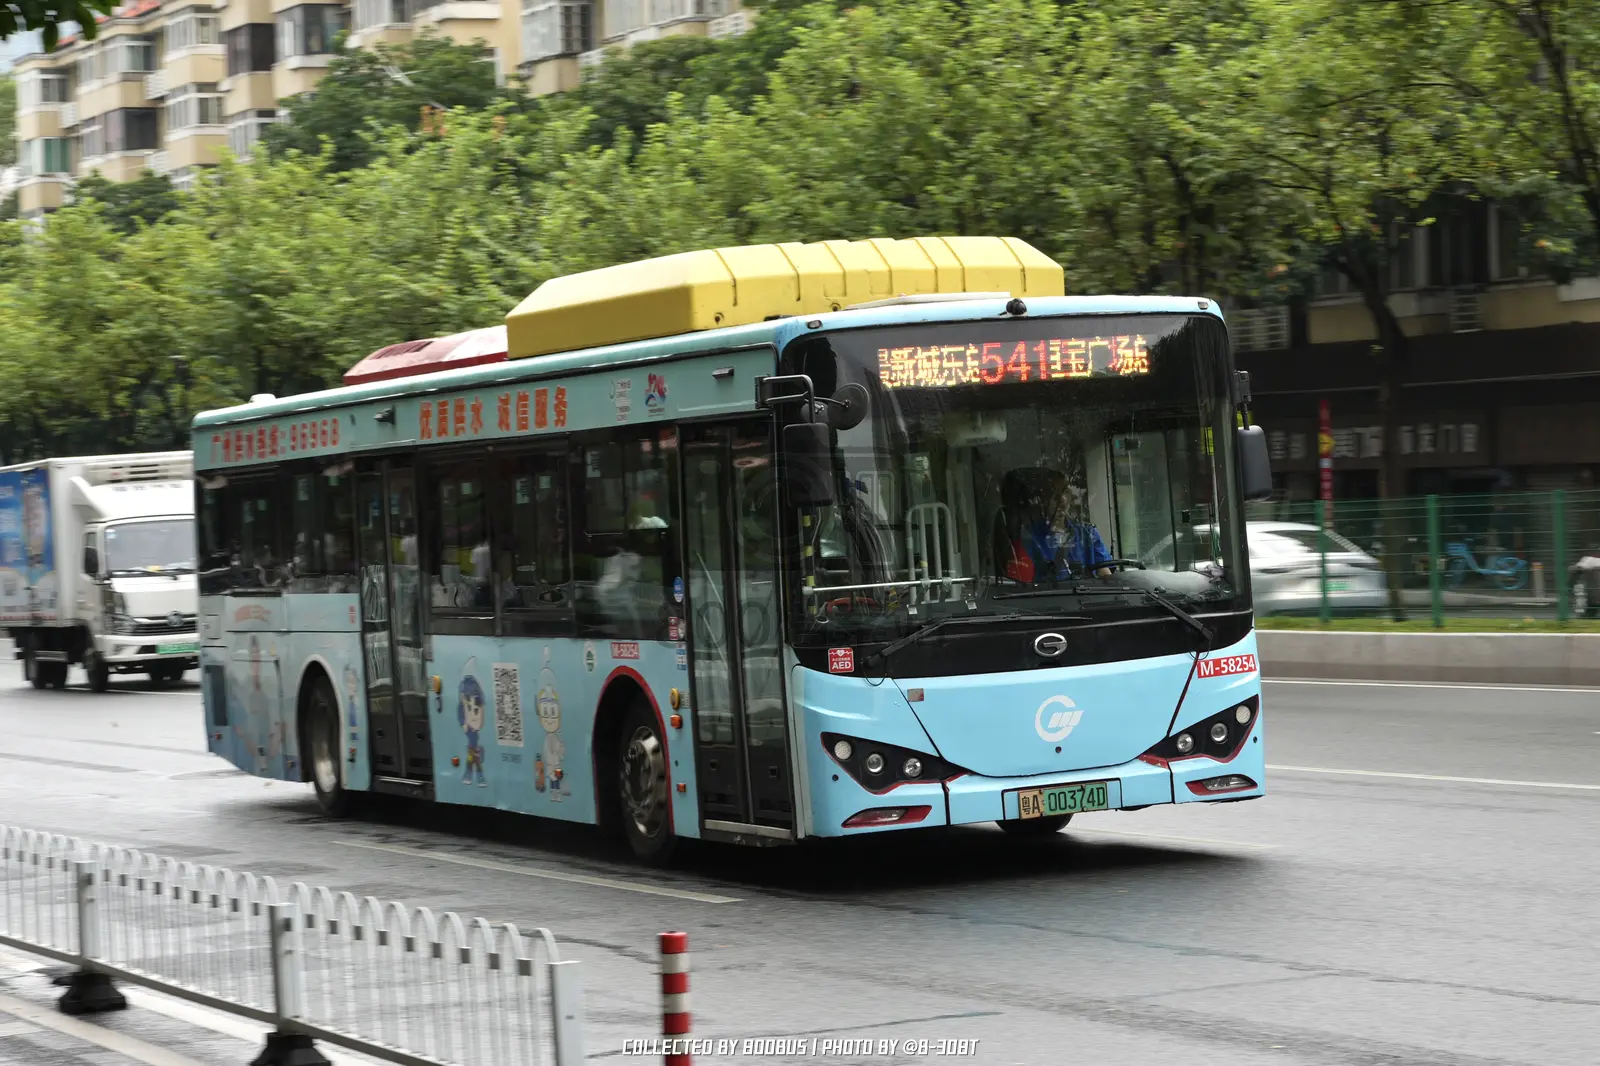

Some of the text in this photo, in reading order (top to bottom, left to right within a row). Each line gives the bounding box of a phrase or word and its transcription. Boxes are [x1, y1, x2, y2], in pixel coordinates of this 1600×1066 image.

[981, 340, 1048, 384] 541
[831, 661, 852, 670] AED
[1200, 655, 1256, 677] M-58254
